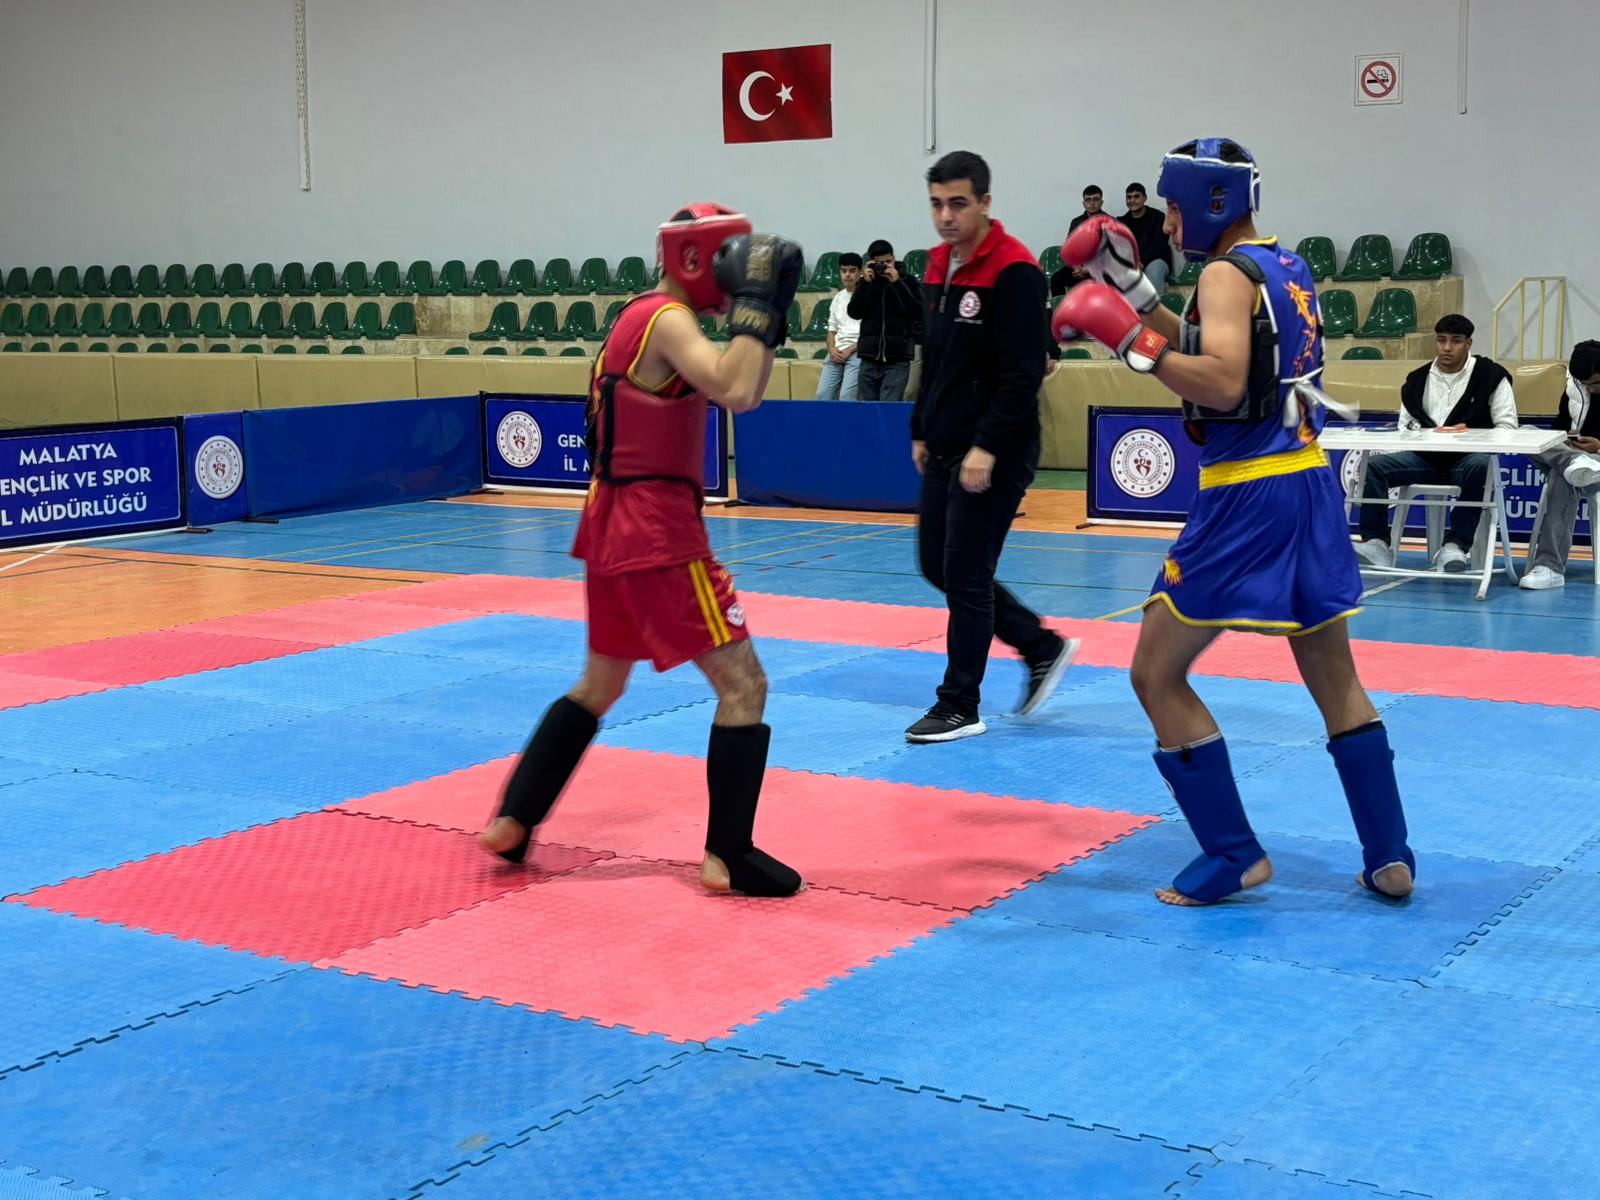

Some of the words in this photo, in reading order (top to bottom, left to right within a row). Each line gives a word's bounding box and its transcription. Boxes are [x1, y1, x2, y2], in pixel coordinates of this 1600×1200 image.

[20, 443, 118, 466] MALATYA
[564, 454, 578, 471] İL
[0, 470, 70, 497] ENÇLİK
[73, 471, 97, 488] VE
[102, 467, 152, 486] SPOR
[20, 492, 147, 524] MÜDÜRLÜĞÜ
